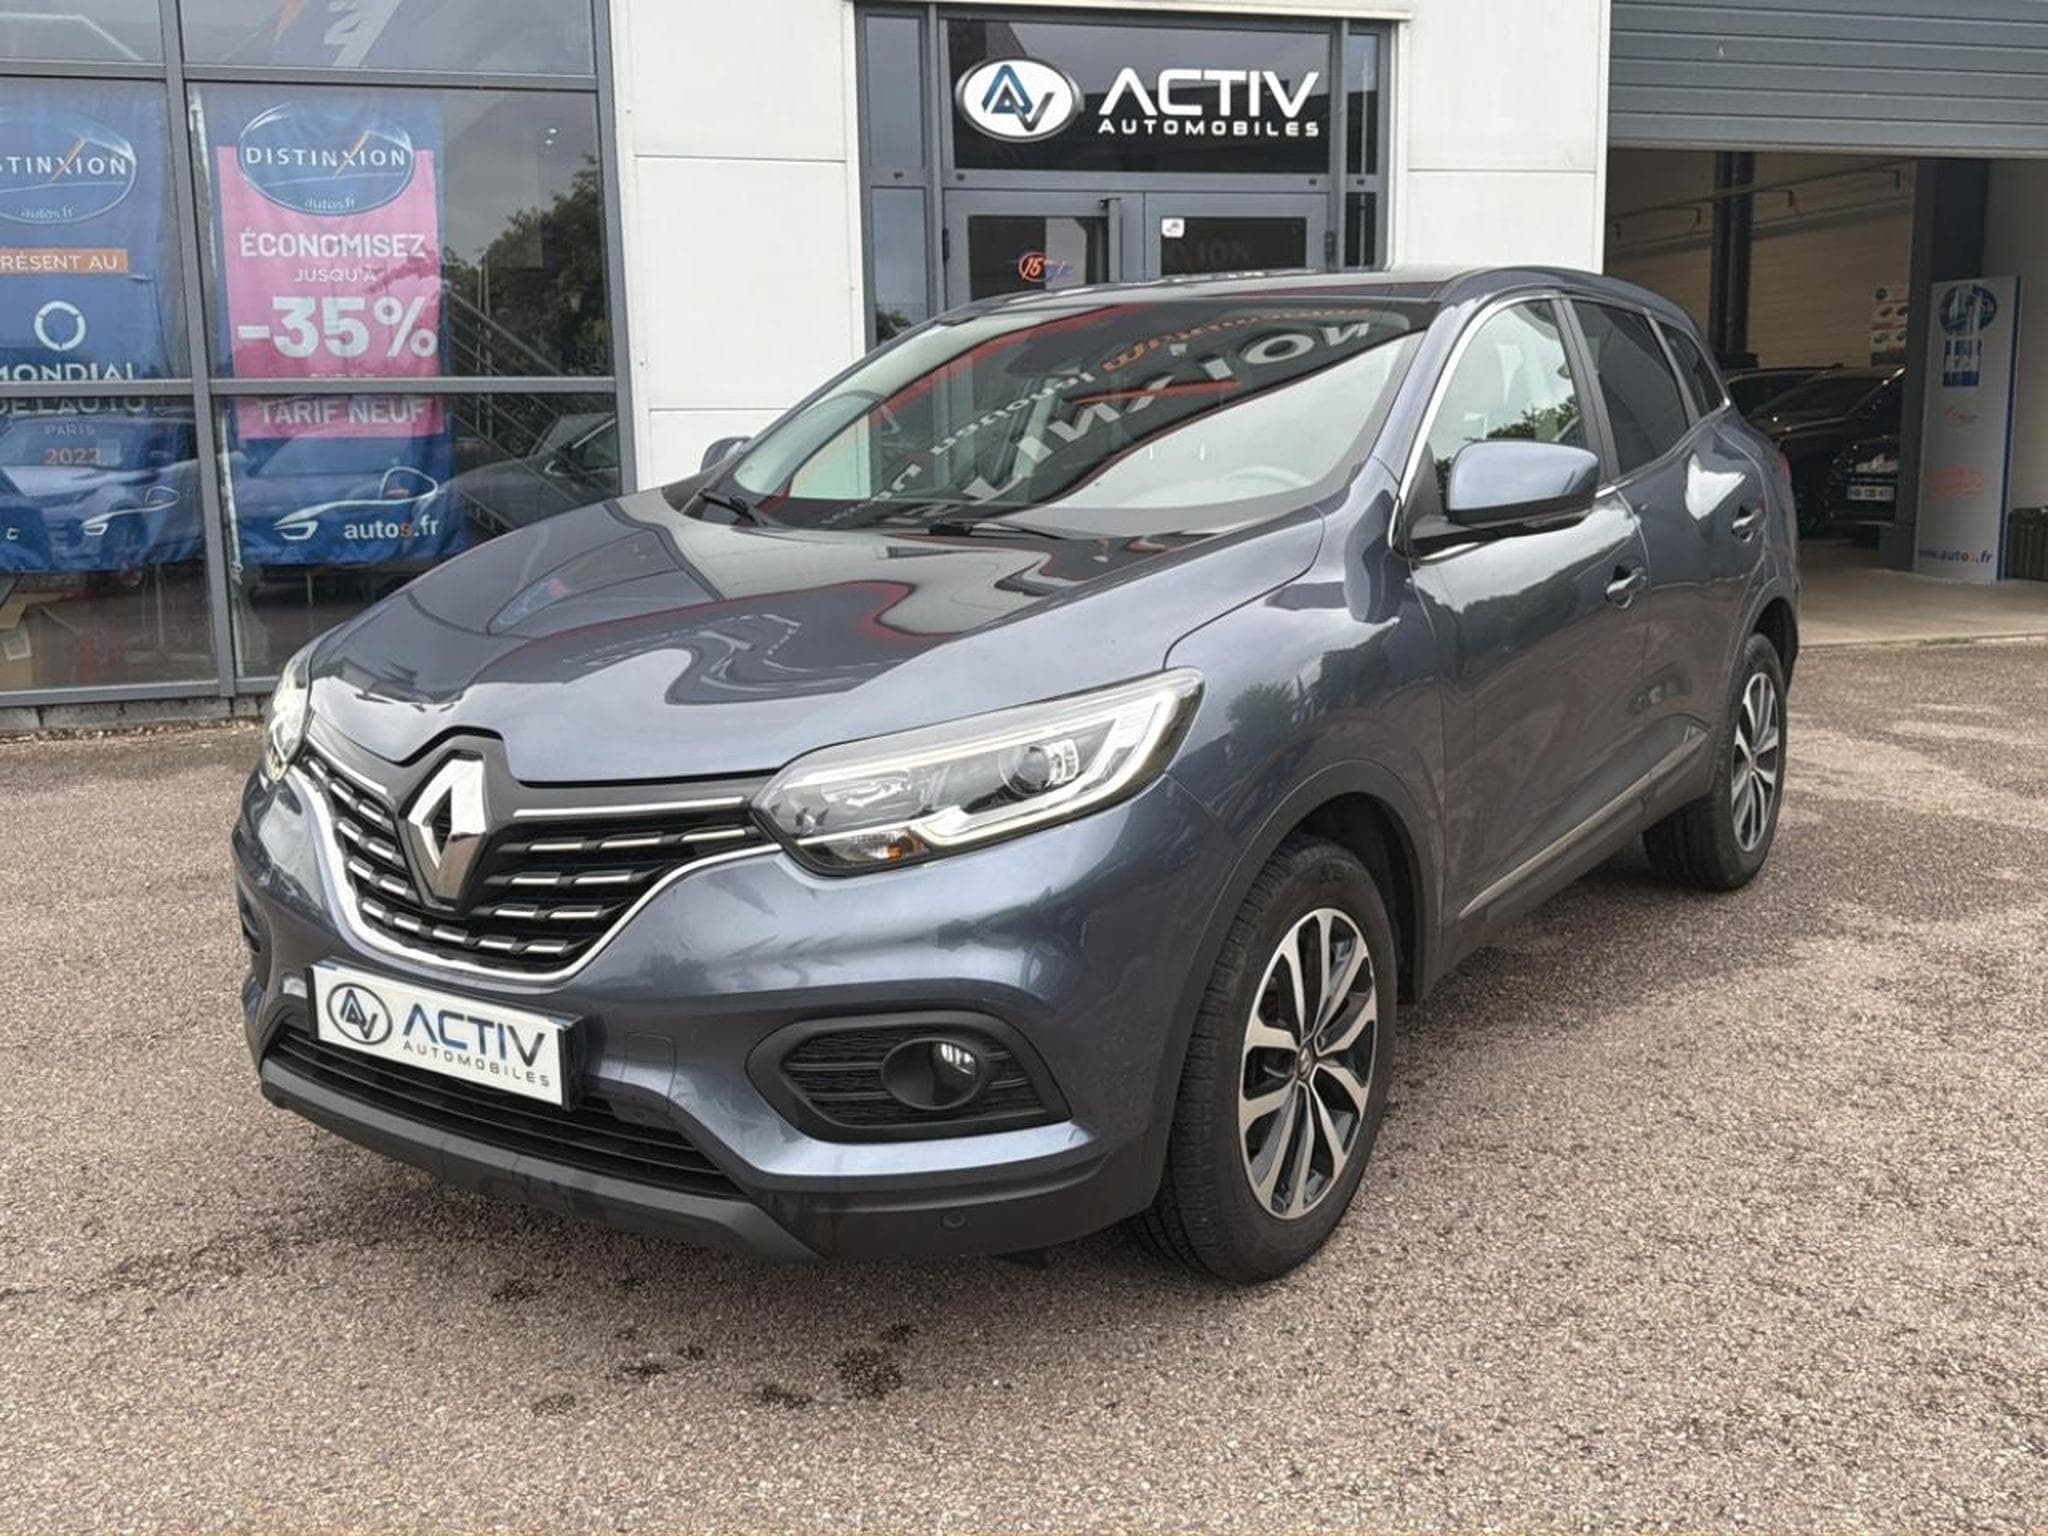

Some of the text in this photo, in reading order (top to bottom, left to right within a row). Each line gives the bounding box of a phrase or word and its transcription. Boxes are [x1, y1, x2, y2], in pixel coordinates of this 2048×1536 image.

[1098, 67, 1320, 119] ACTIV
[1098, 119, 1320, 137] AUTOMOBILES
[245, 138, 406, 174] DISTINXION
[239, 228, 426, 258] ÉCONOMISEZ
[88, 255, 118, 271] AU
[237, 295, 438, 359] -35%
[258, 400, 425, 426] TARIF NEUF
[343, 514, 439, 539] autos.fr
[403, 1003, 545, 1067] ACTIV
[403, 1040, 550, 1087] AUTOMOBILES
